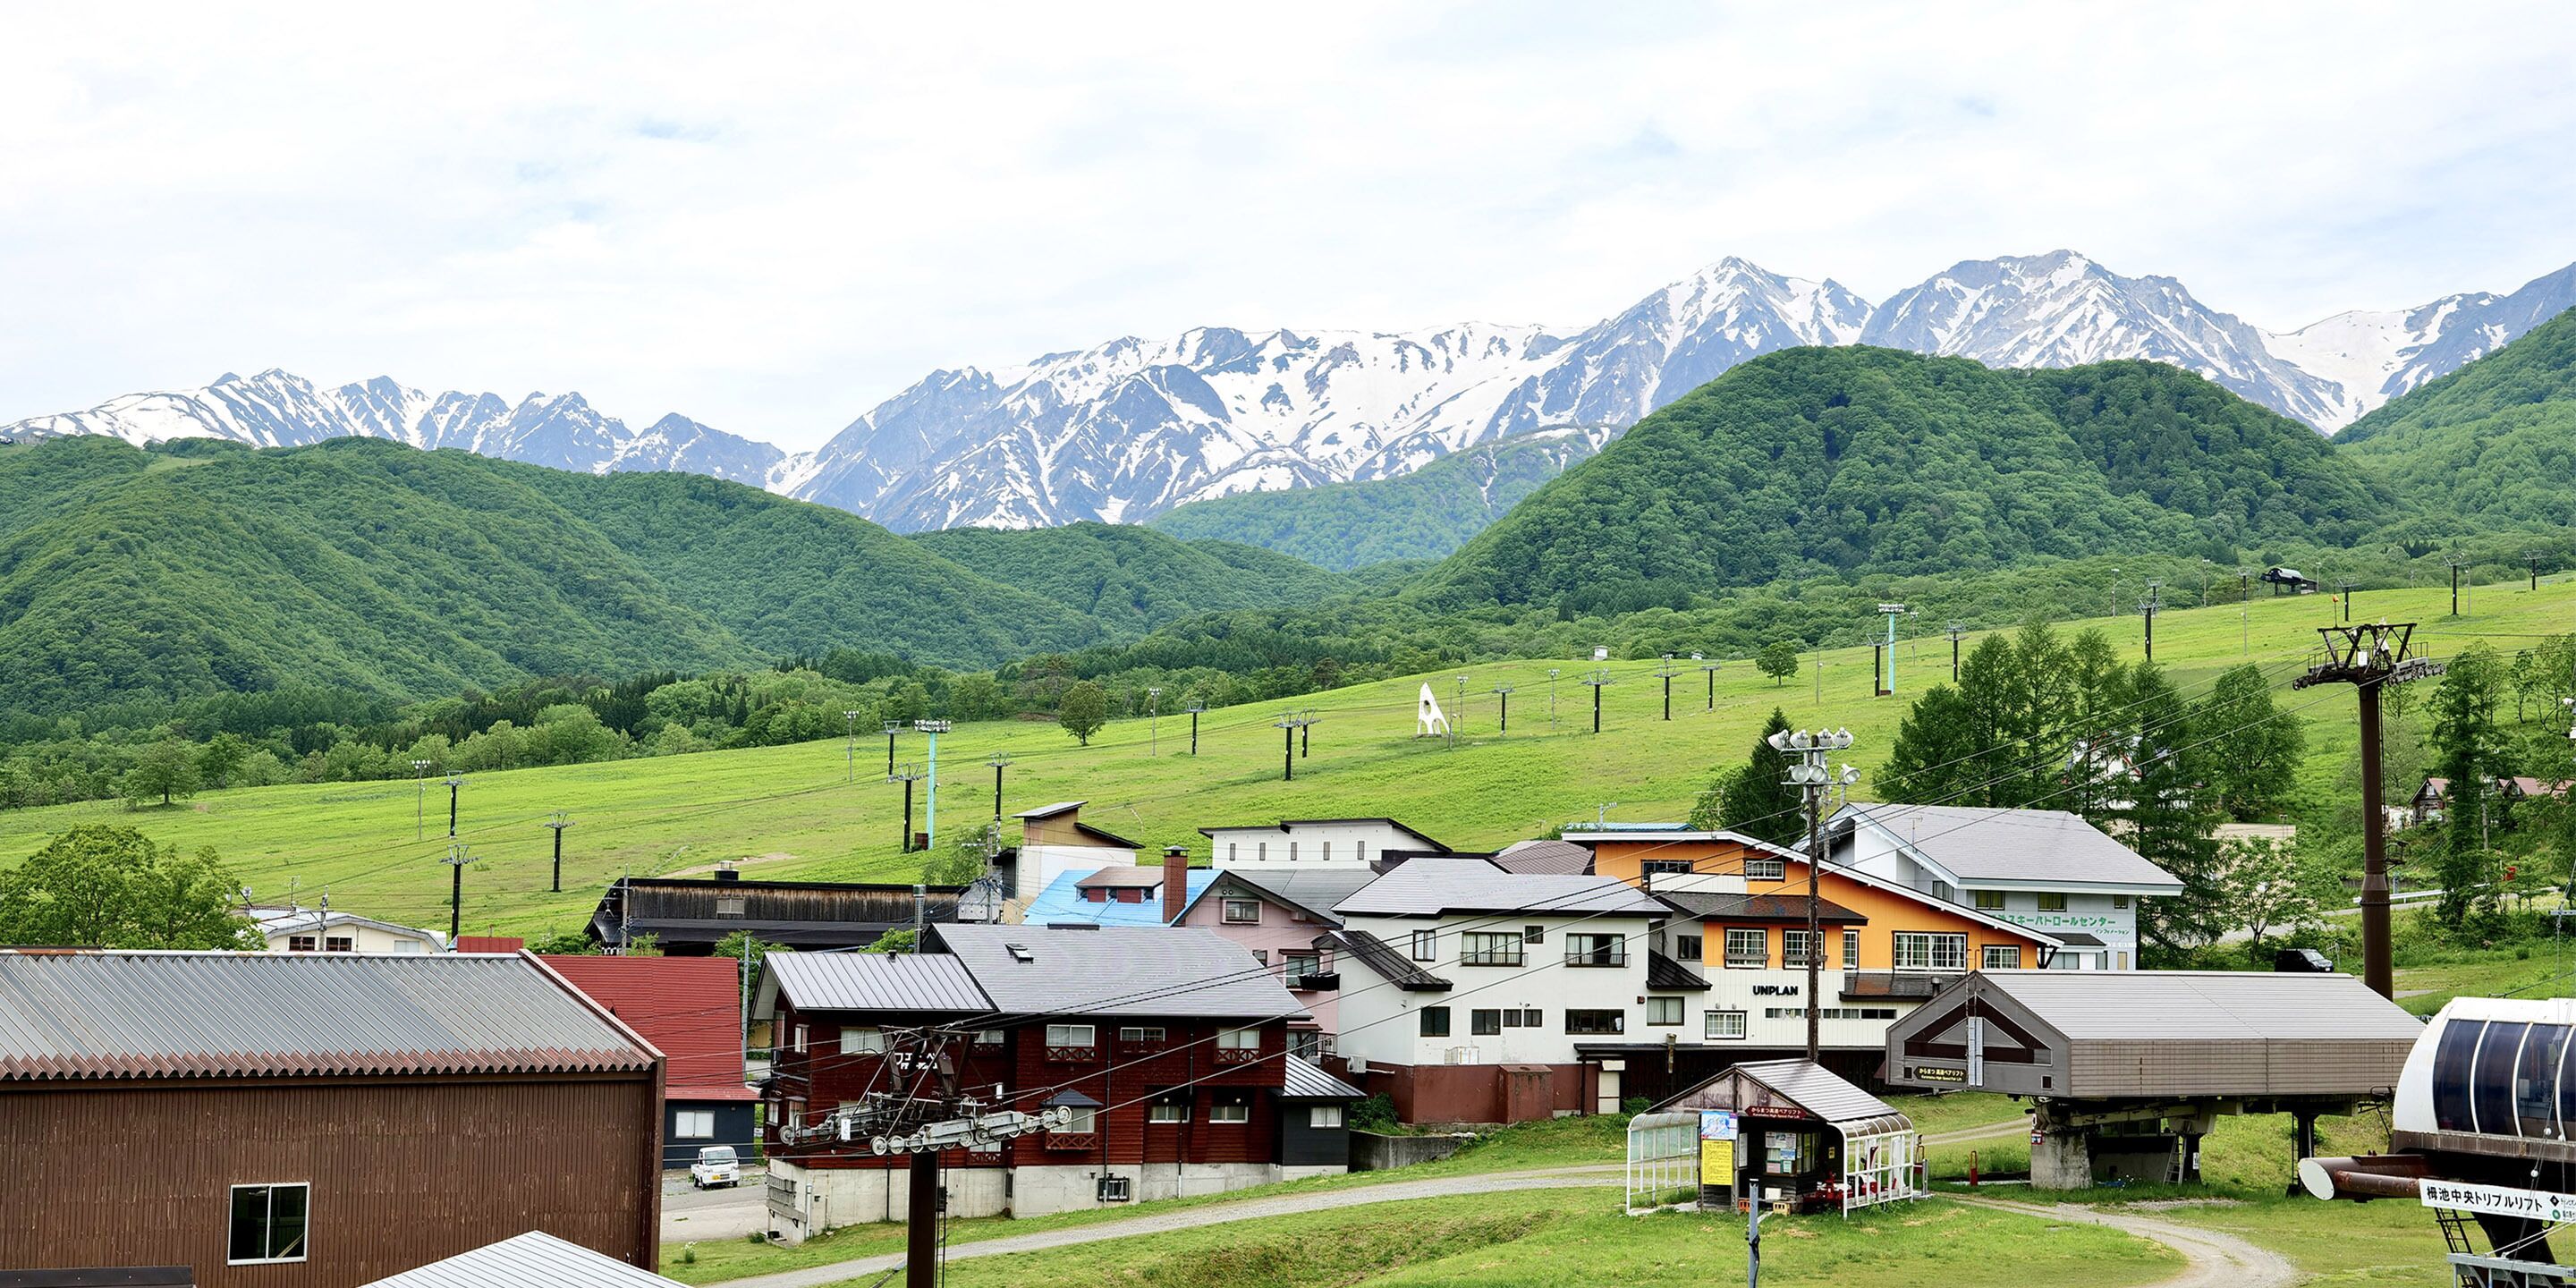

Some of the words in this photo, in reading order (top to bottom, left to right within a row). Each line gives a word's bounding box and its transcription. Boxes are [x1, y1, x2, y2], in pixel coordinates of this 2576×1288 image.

[1752, 985, 1799, 996] UNPLAN
[2427, 1185, 2543, 1213] 栂池中央トリプルリフト
